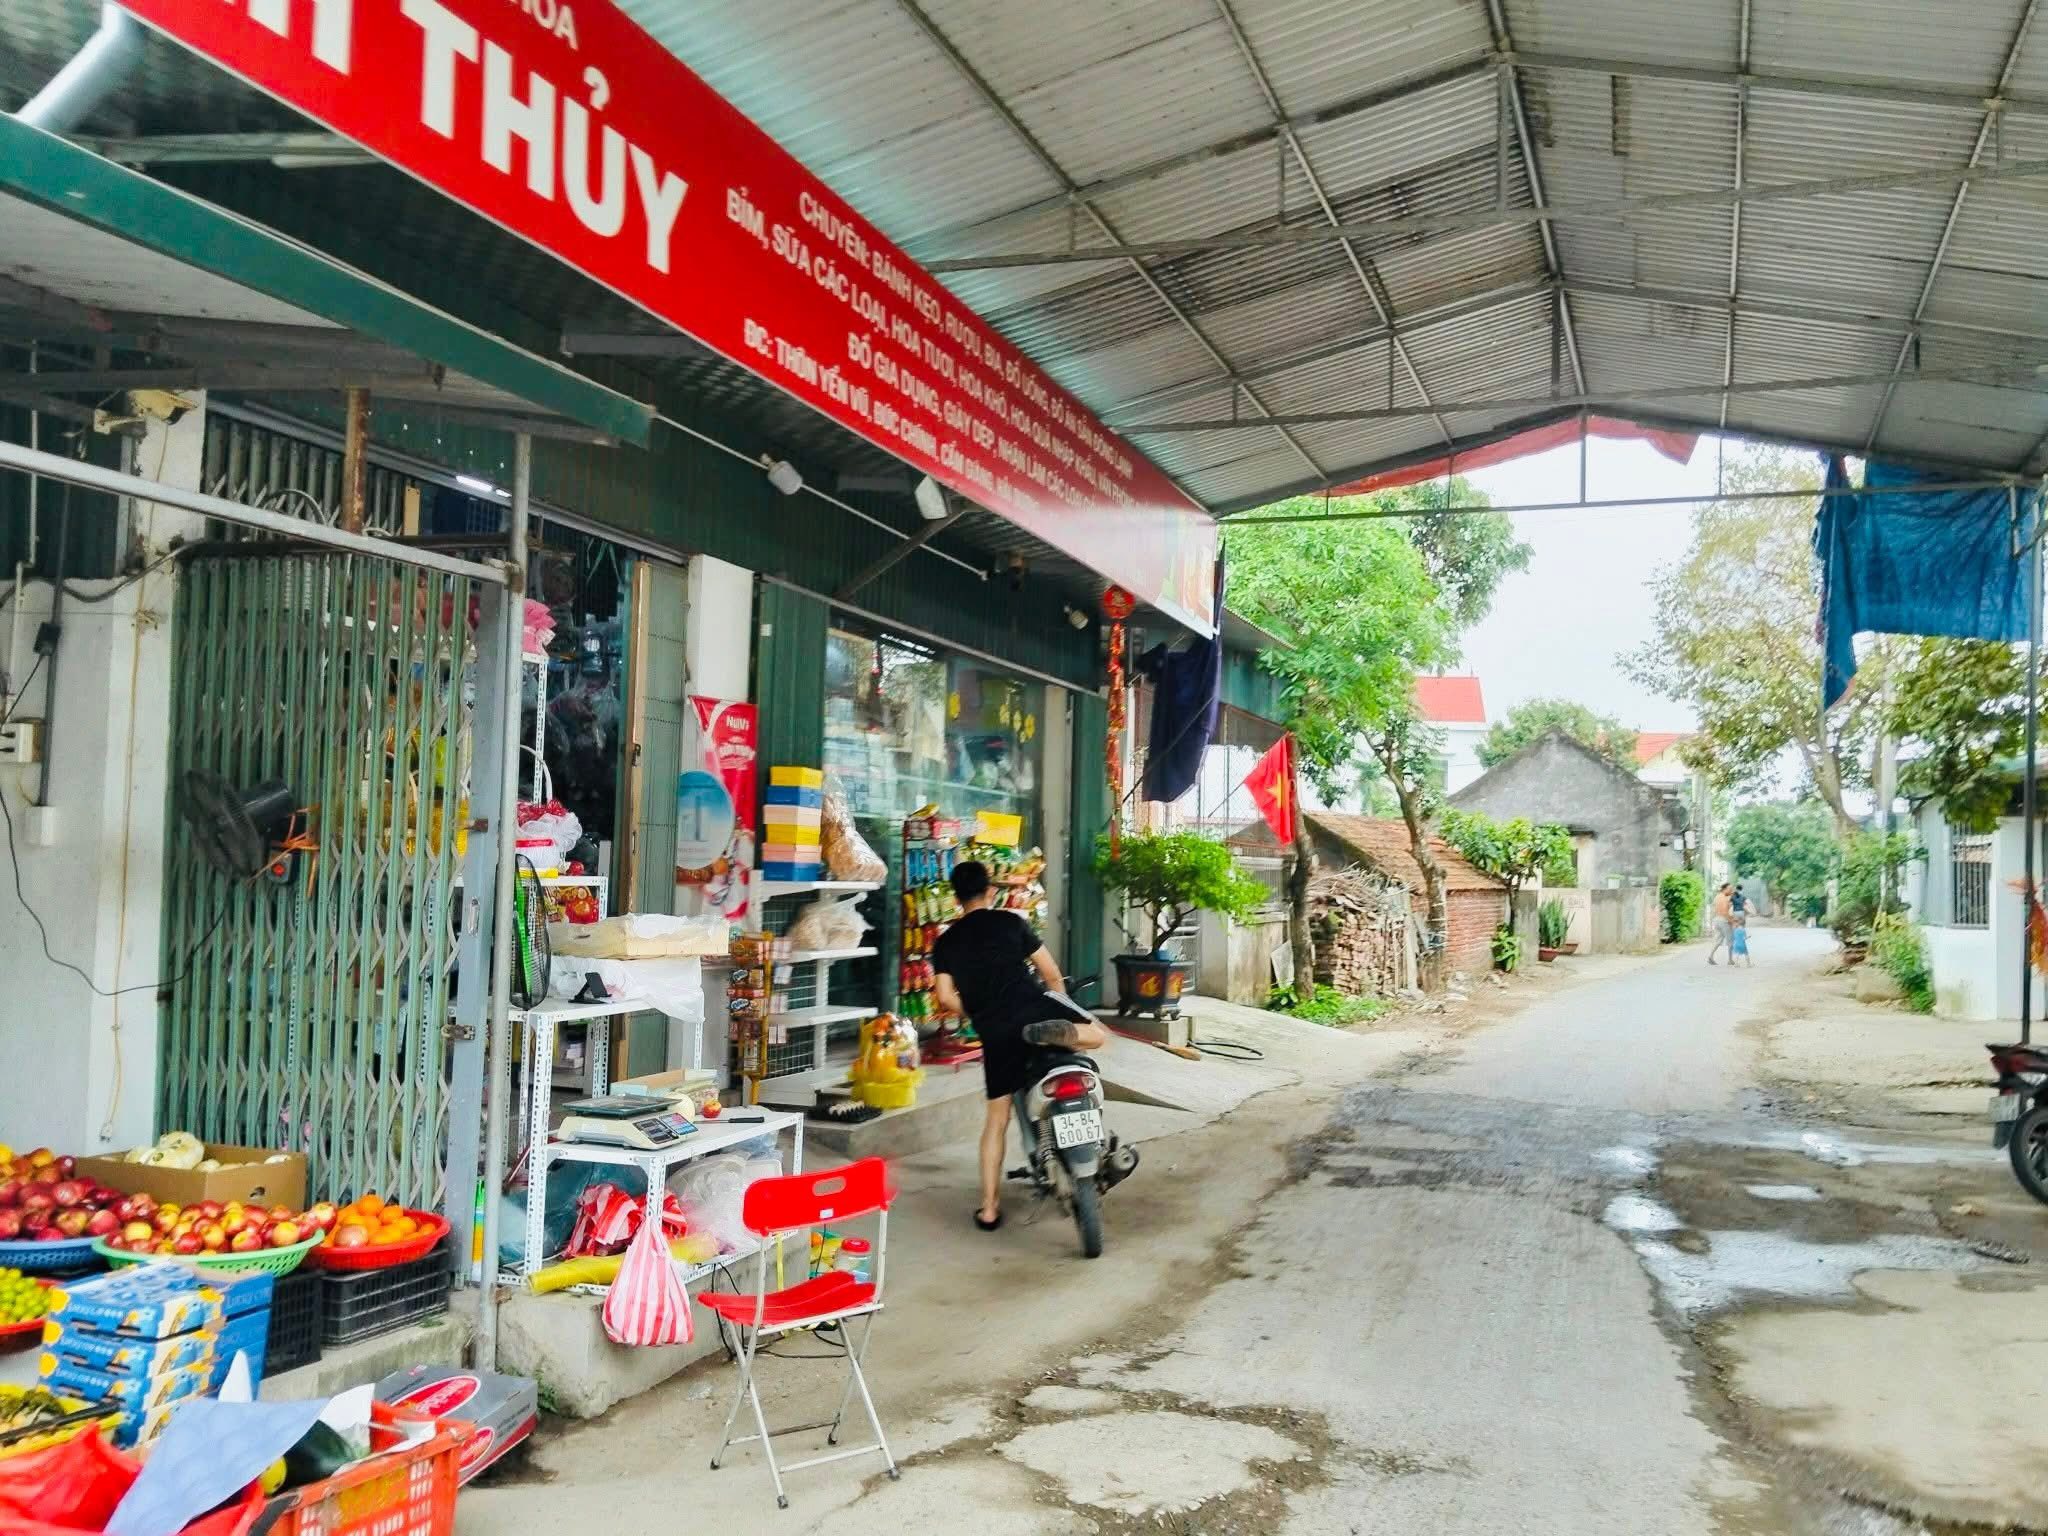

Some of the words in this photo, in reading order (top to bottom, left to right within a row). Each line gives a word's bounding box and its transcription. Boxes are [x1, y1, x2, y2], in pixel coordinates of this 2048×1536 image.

[510, 0, 578, 50] OA
[400, 0, 689, 275] THỦY
[727, 186, 769, 250] BỈM,
[771, 223, 812, 277] SỮA
[814, 256, 849, 302] CÁC
[851, 283, 890, 338] LOẠI,
[891, 314, 921, 358] HOA
[959, 365, 983, 402] HOA
[800, 191, 870, 270] CHUYÊN:
[872, 250, 912, 302] BÁNH
[914, 284, 944, 333] KẸO,
[774, 336, 817, 386] THÔN
[847, 332, 872, 370] ĐỒ
[873, 351, 899, 390] GIA
[901, 368, 942, 422] DỤNG,
[1059, 1125, 1100, 1145] 600.67
[1060, 1112, 1094, 1130] 34-B4
